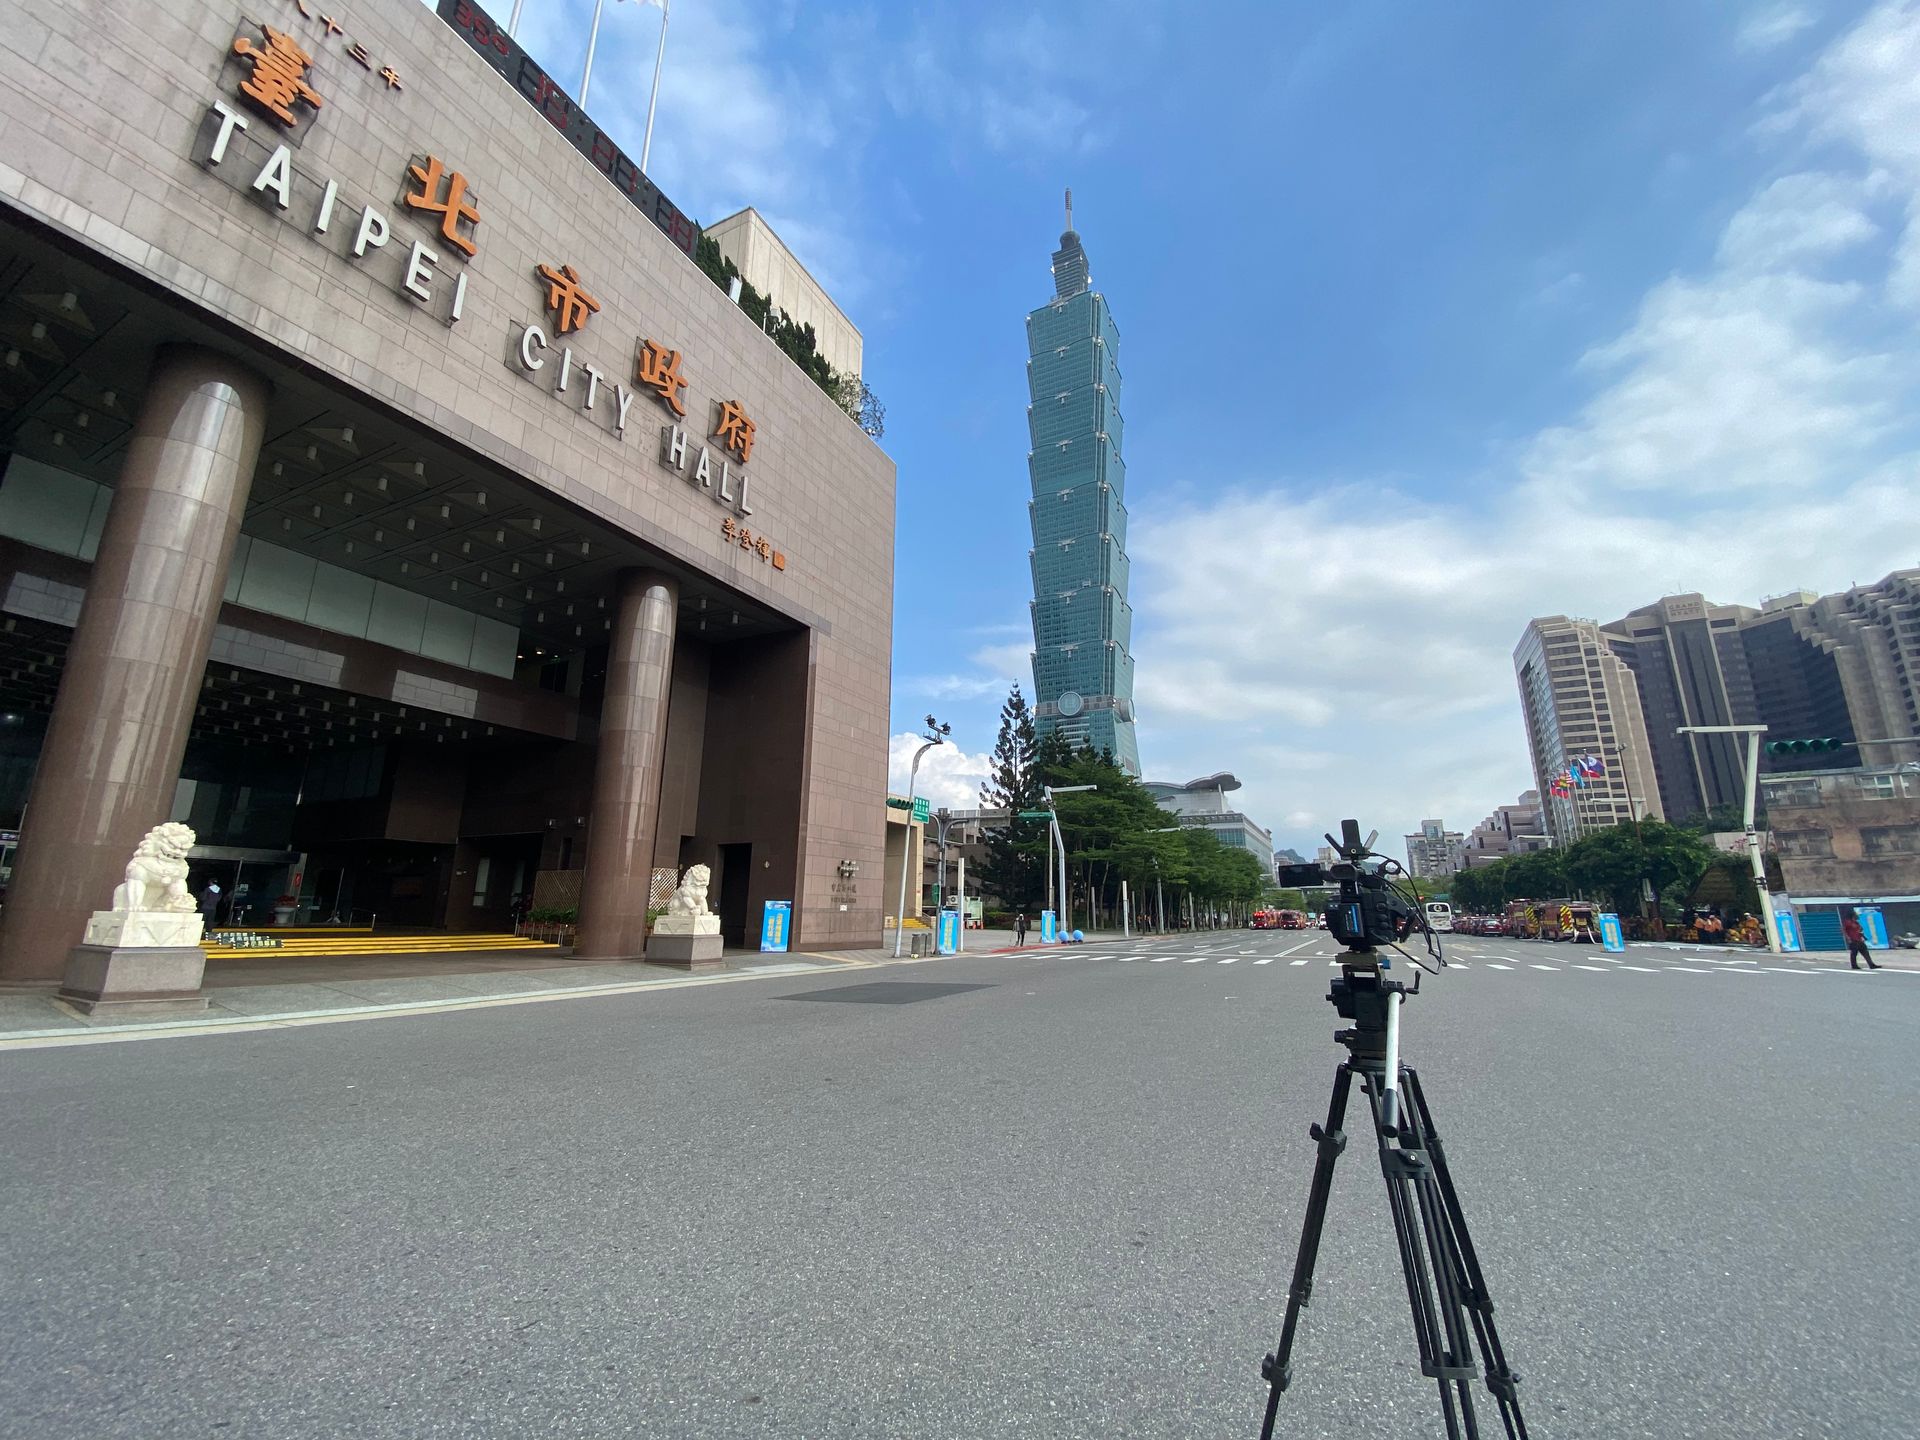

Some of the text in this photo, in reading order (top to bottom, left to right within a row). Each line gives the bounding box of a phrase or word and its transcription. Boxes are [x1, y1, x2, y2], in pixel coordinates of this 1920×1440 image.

[233, 23, 757, 463] 臺北市政府
[296, 0, 403, 91] 十三年
[206, 99, 753, 516] TAIPEI CITY HALL
